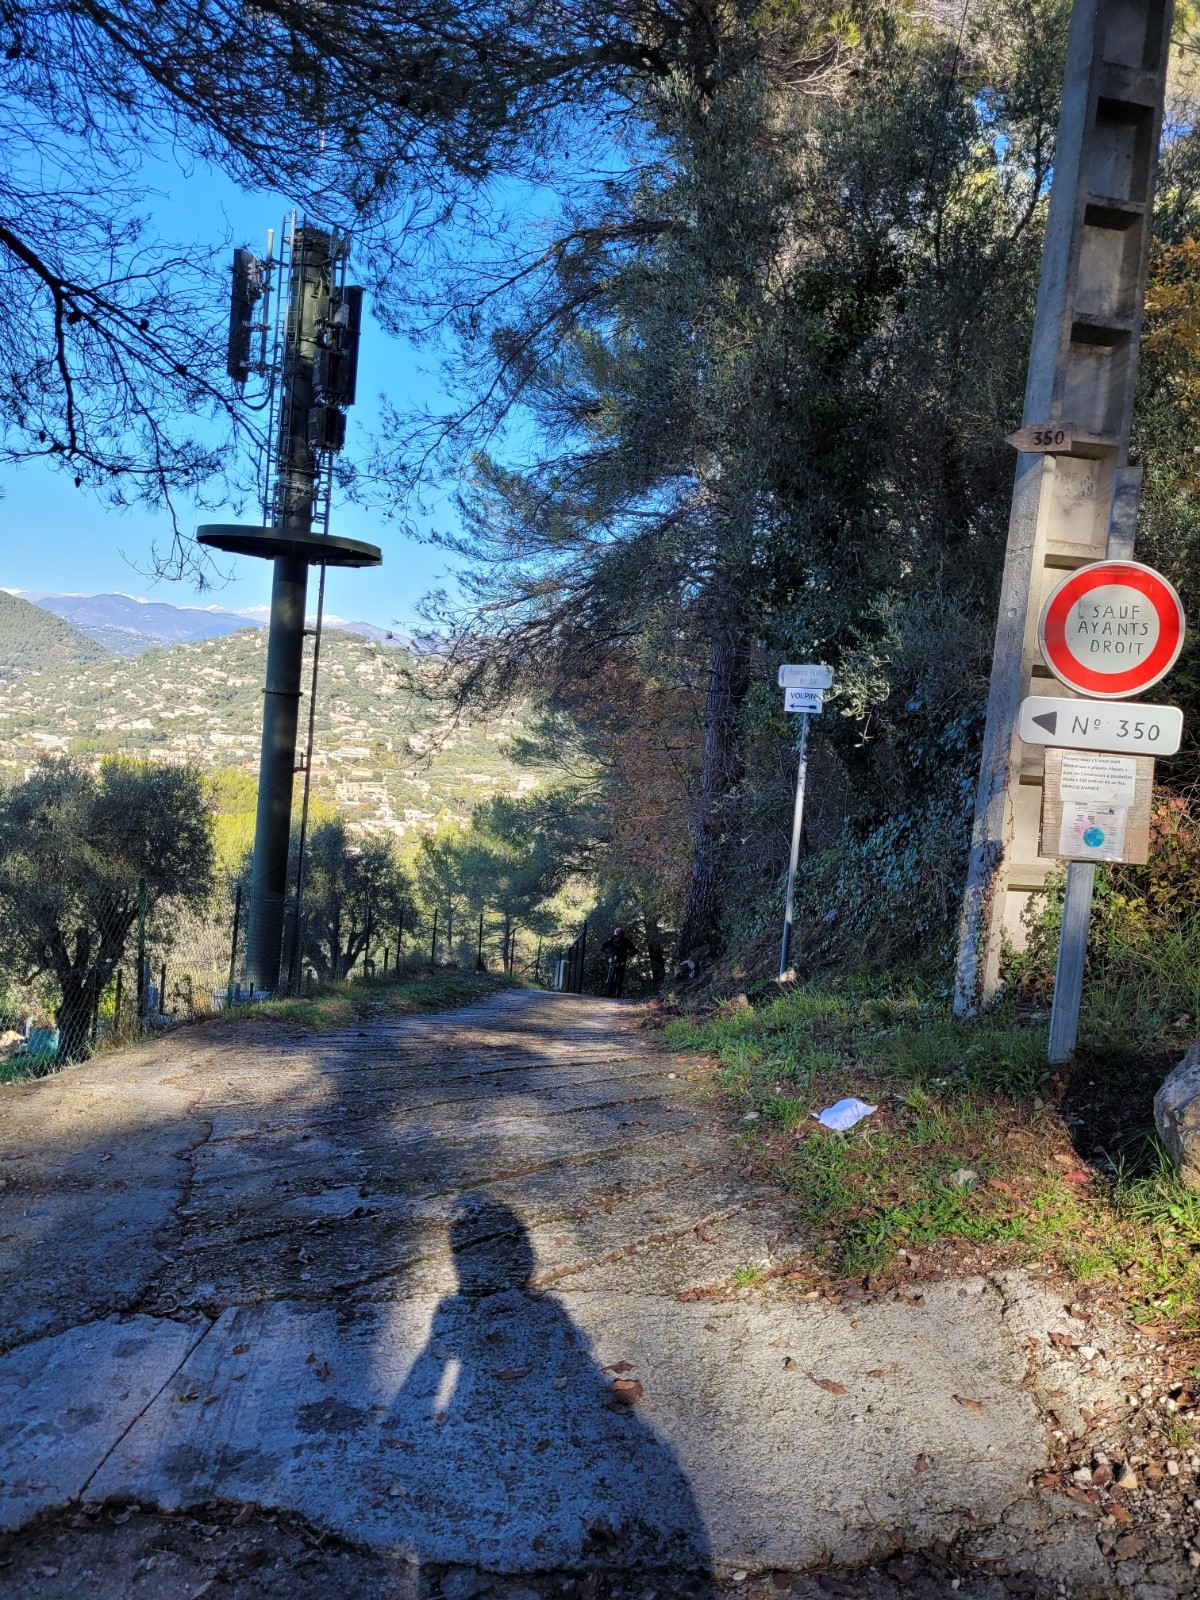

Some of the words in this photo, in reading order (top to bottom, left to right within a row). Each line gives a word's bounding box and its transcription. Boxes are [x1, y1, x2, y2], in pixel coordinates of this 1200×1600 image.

[1033, 430, 1065, 446] 350
[1092, 604, 1140, 619] SAUF
[1078, 622, 1149, 636] AYANTS
[1090, 639, 1145, 656] DROIT
[1116, 719, 1161, 741] 350
